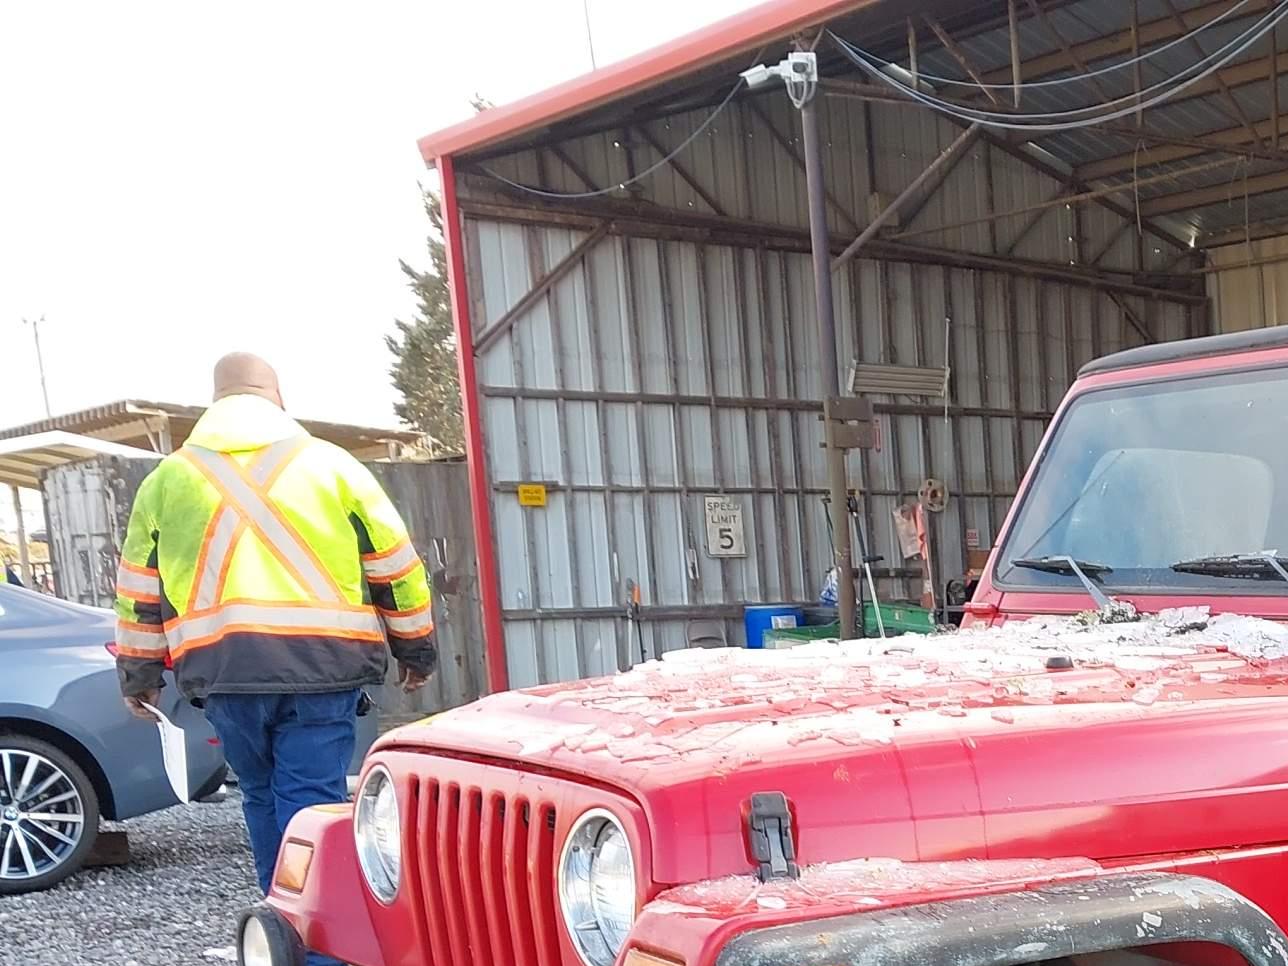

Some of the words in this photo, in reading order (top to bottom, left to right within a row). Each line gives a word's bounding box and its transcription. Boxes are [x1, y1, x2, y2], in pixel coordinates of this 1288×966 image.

[707, 502, 740, 511] SPEED
[711, 514, 737, 524] LIMIT
[719, 528, 734, 549] 5
